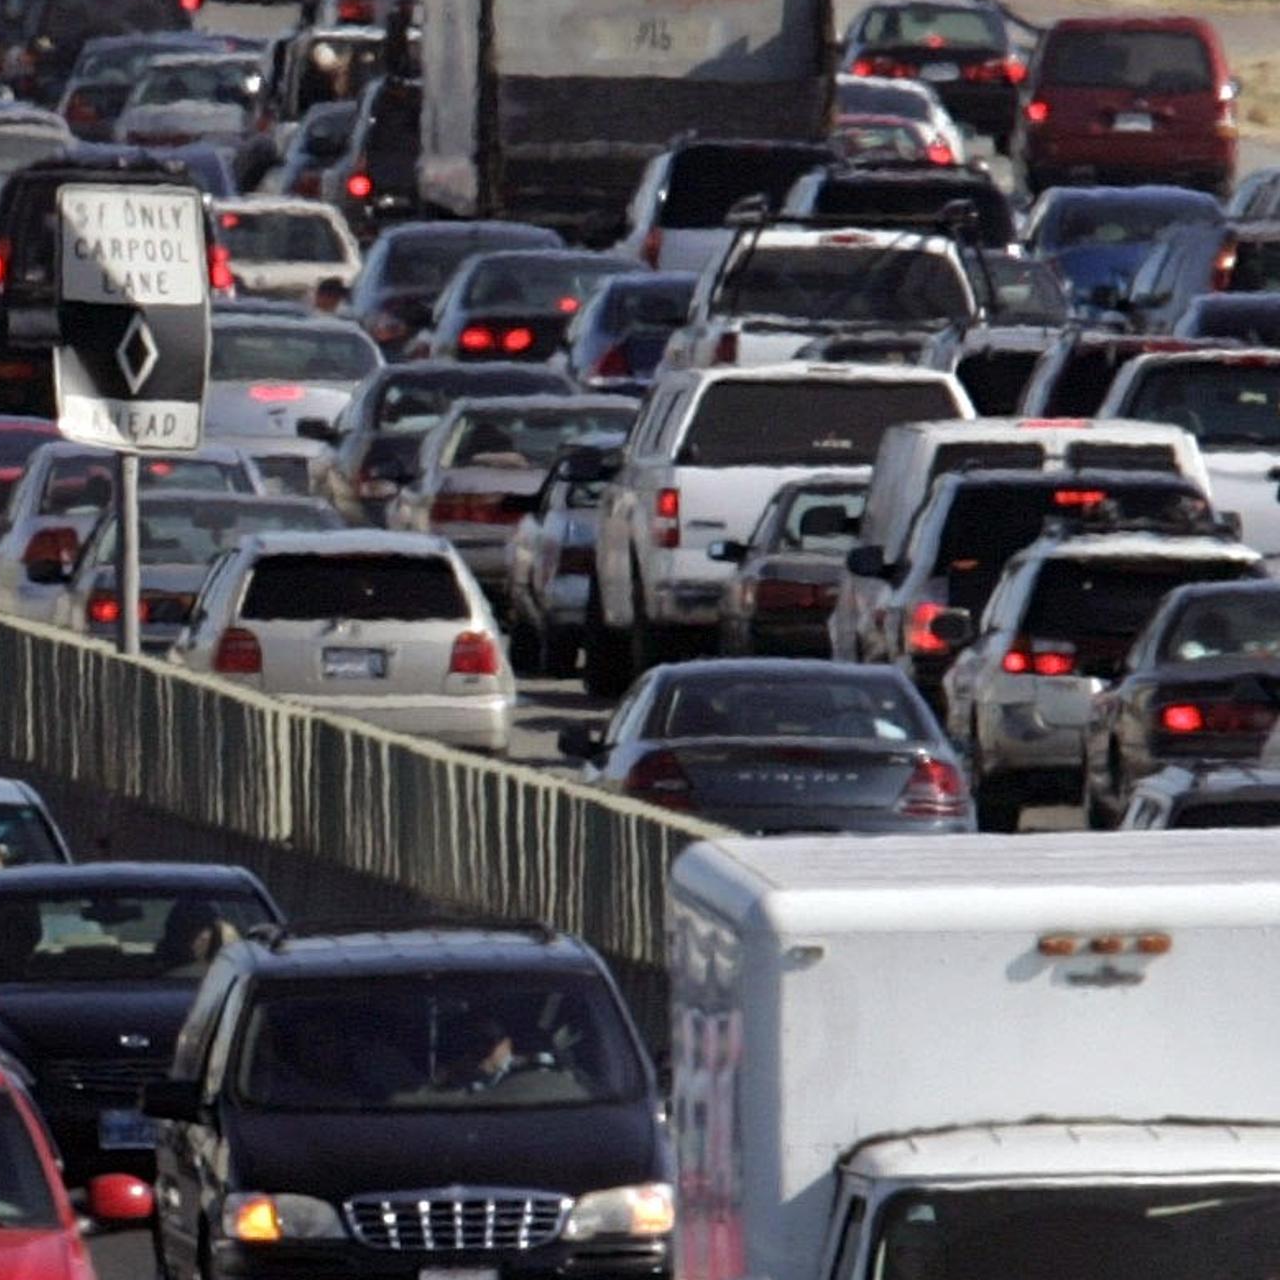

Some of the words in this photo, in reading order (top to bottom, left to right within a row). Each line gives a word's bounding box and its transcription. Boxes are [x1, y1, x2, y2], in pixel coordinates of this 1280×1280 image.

[123, 200, 186, 228] ONLY
[73, 238, 189, 264] CARPOOL
[101, 271, 169, 296] LANE
